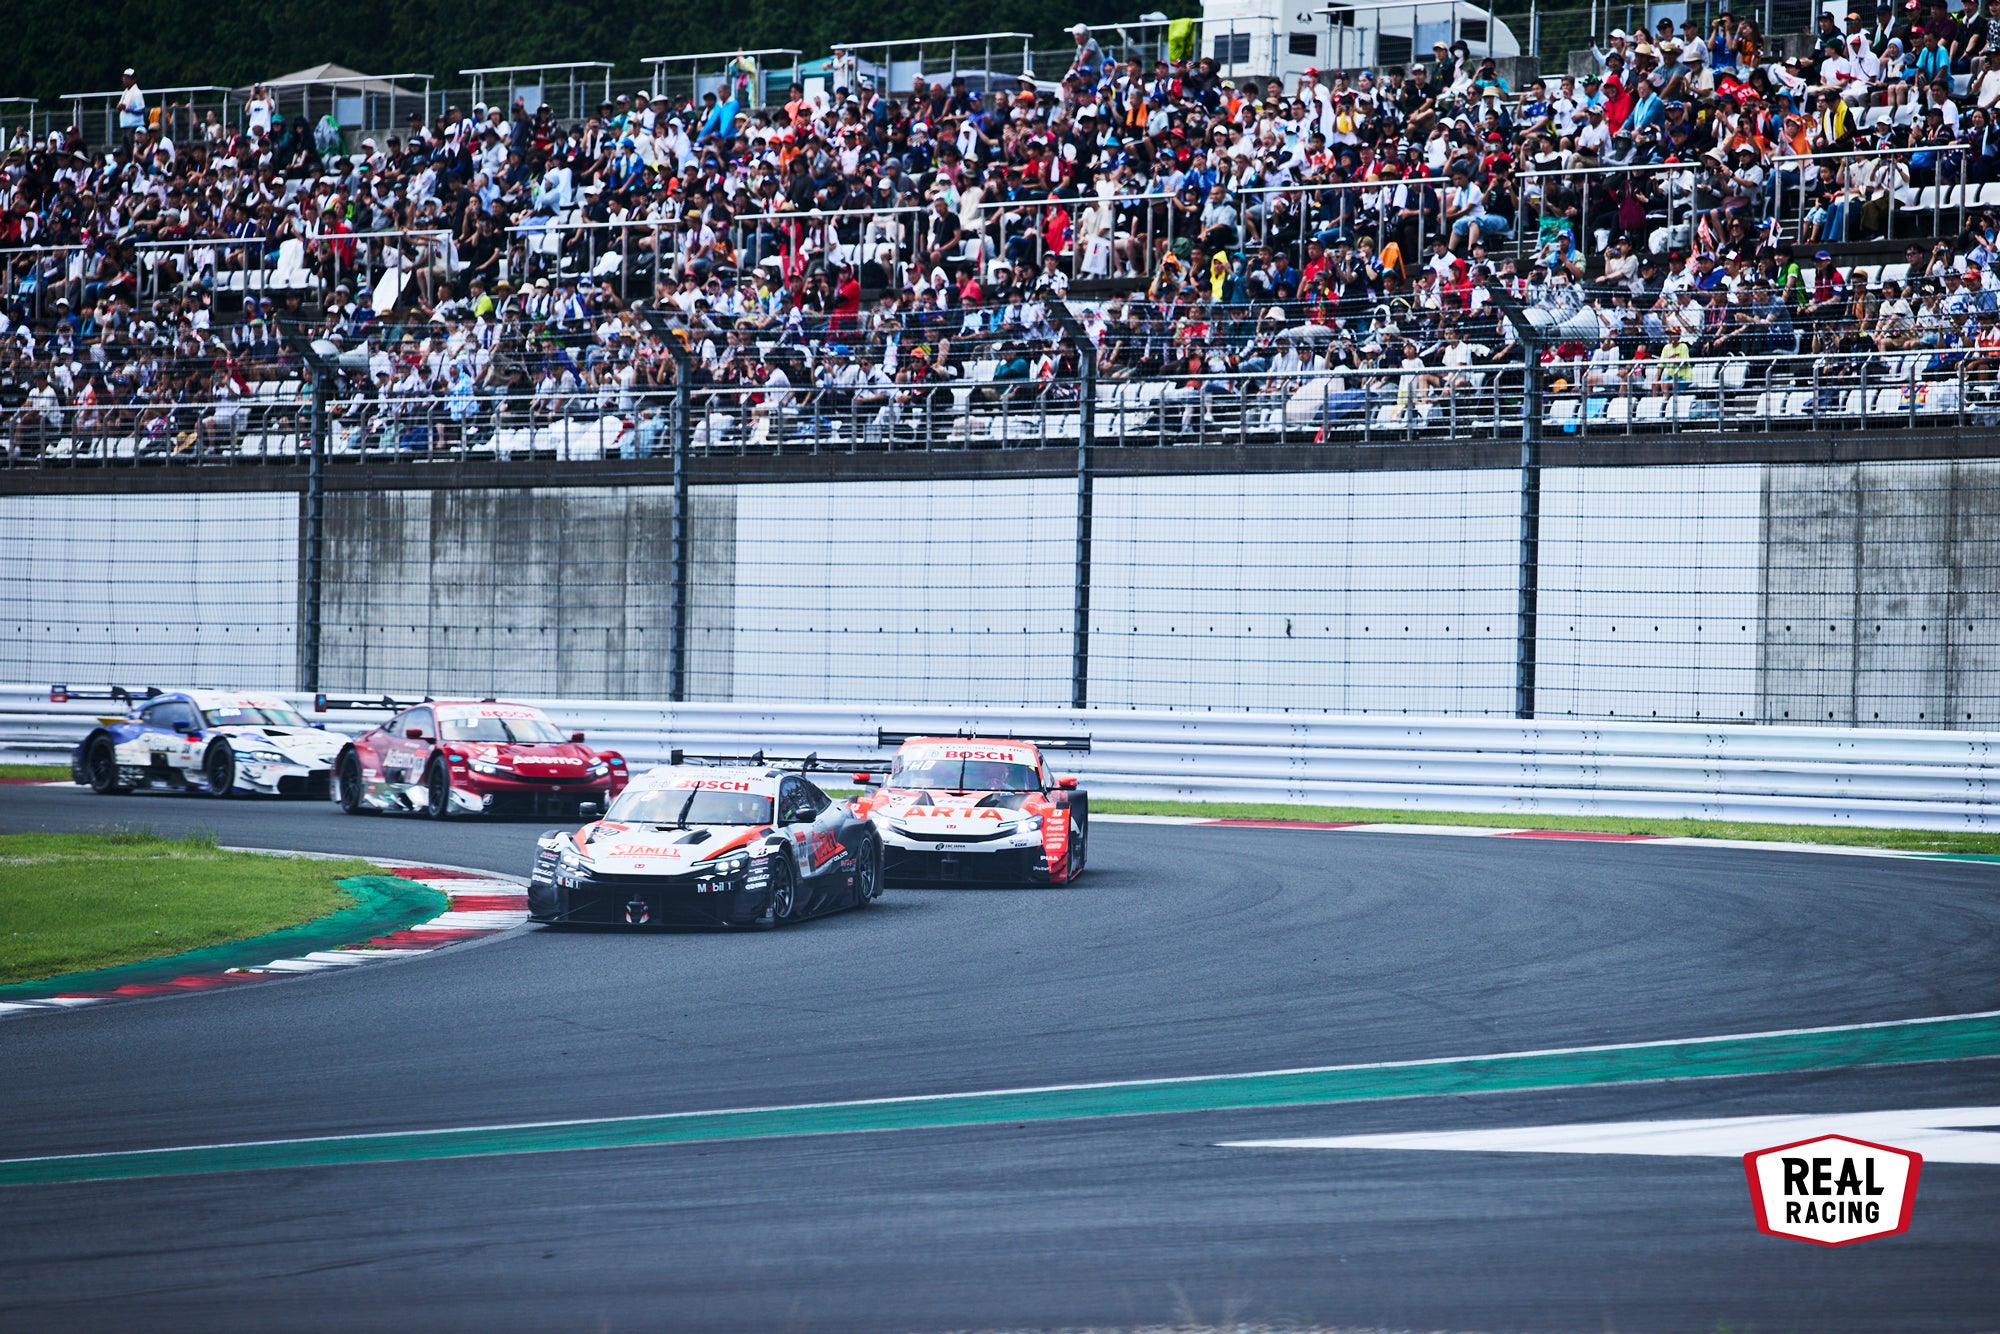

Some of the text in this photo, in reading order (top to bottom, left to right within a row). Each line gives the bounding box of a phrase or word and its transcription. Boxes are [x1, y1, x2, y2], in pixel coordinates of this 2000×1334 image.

[481, 710, 535, 719] BOSCH
[512, 755, 583, 766] Astemo
[945, 751, 1013, 761] BOSCH
[675, 780, 750, 791] BOSCH
[902, 807, 1004, 822] ARTA
[609, 842, 681, 857] STANLEY
[697, 882, 725, 893] Mobil
